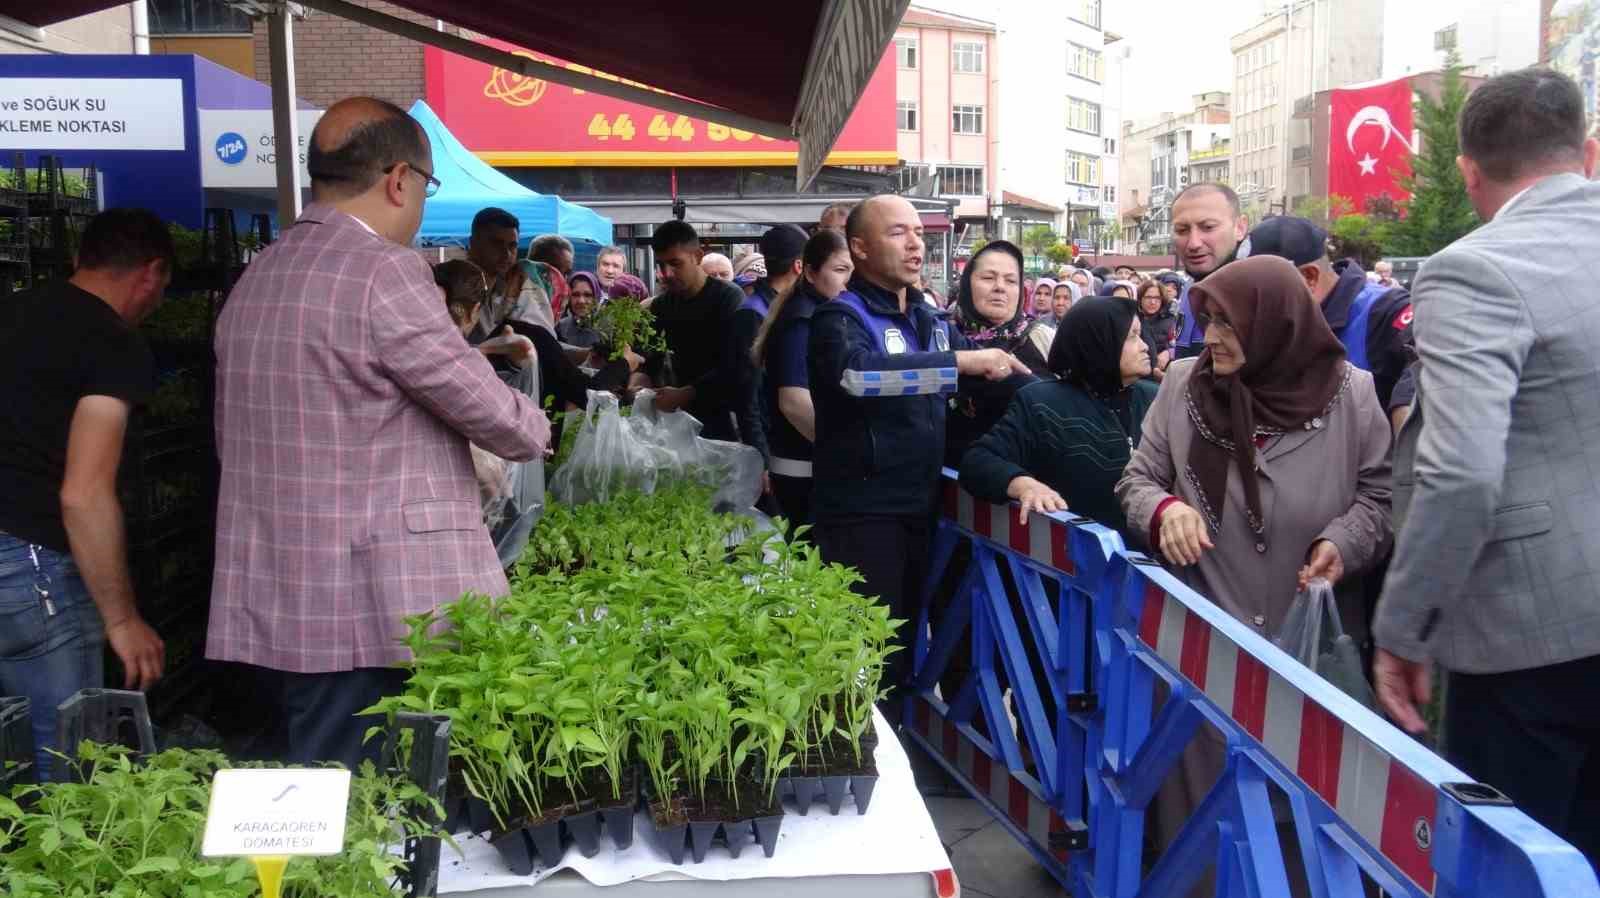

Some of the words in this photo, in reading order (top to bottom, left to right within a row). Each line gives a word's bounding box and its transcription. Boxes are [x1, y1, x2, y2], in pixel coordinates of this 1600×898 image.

[1, 101, 18, 111] ve
[23, 96, 80, 111] SOĞUK
[85, 98, 106, 111] SU
[58, 120, 126, 133] NOKTASI
[588, 113, 636, 141] 44
[647, 114, 695, 141] 44
